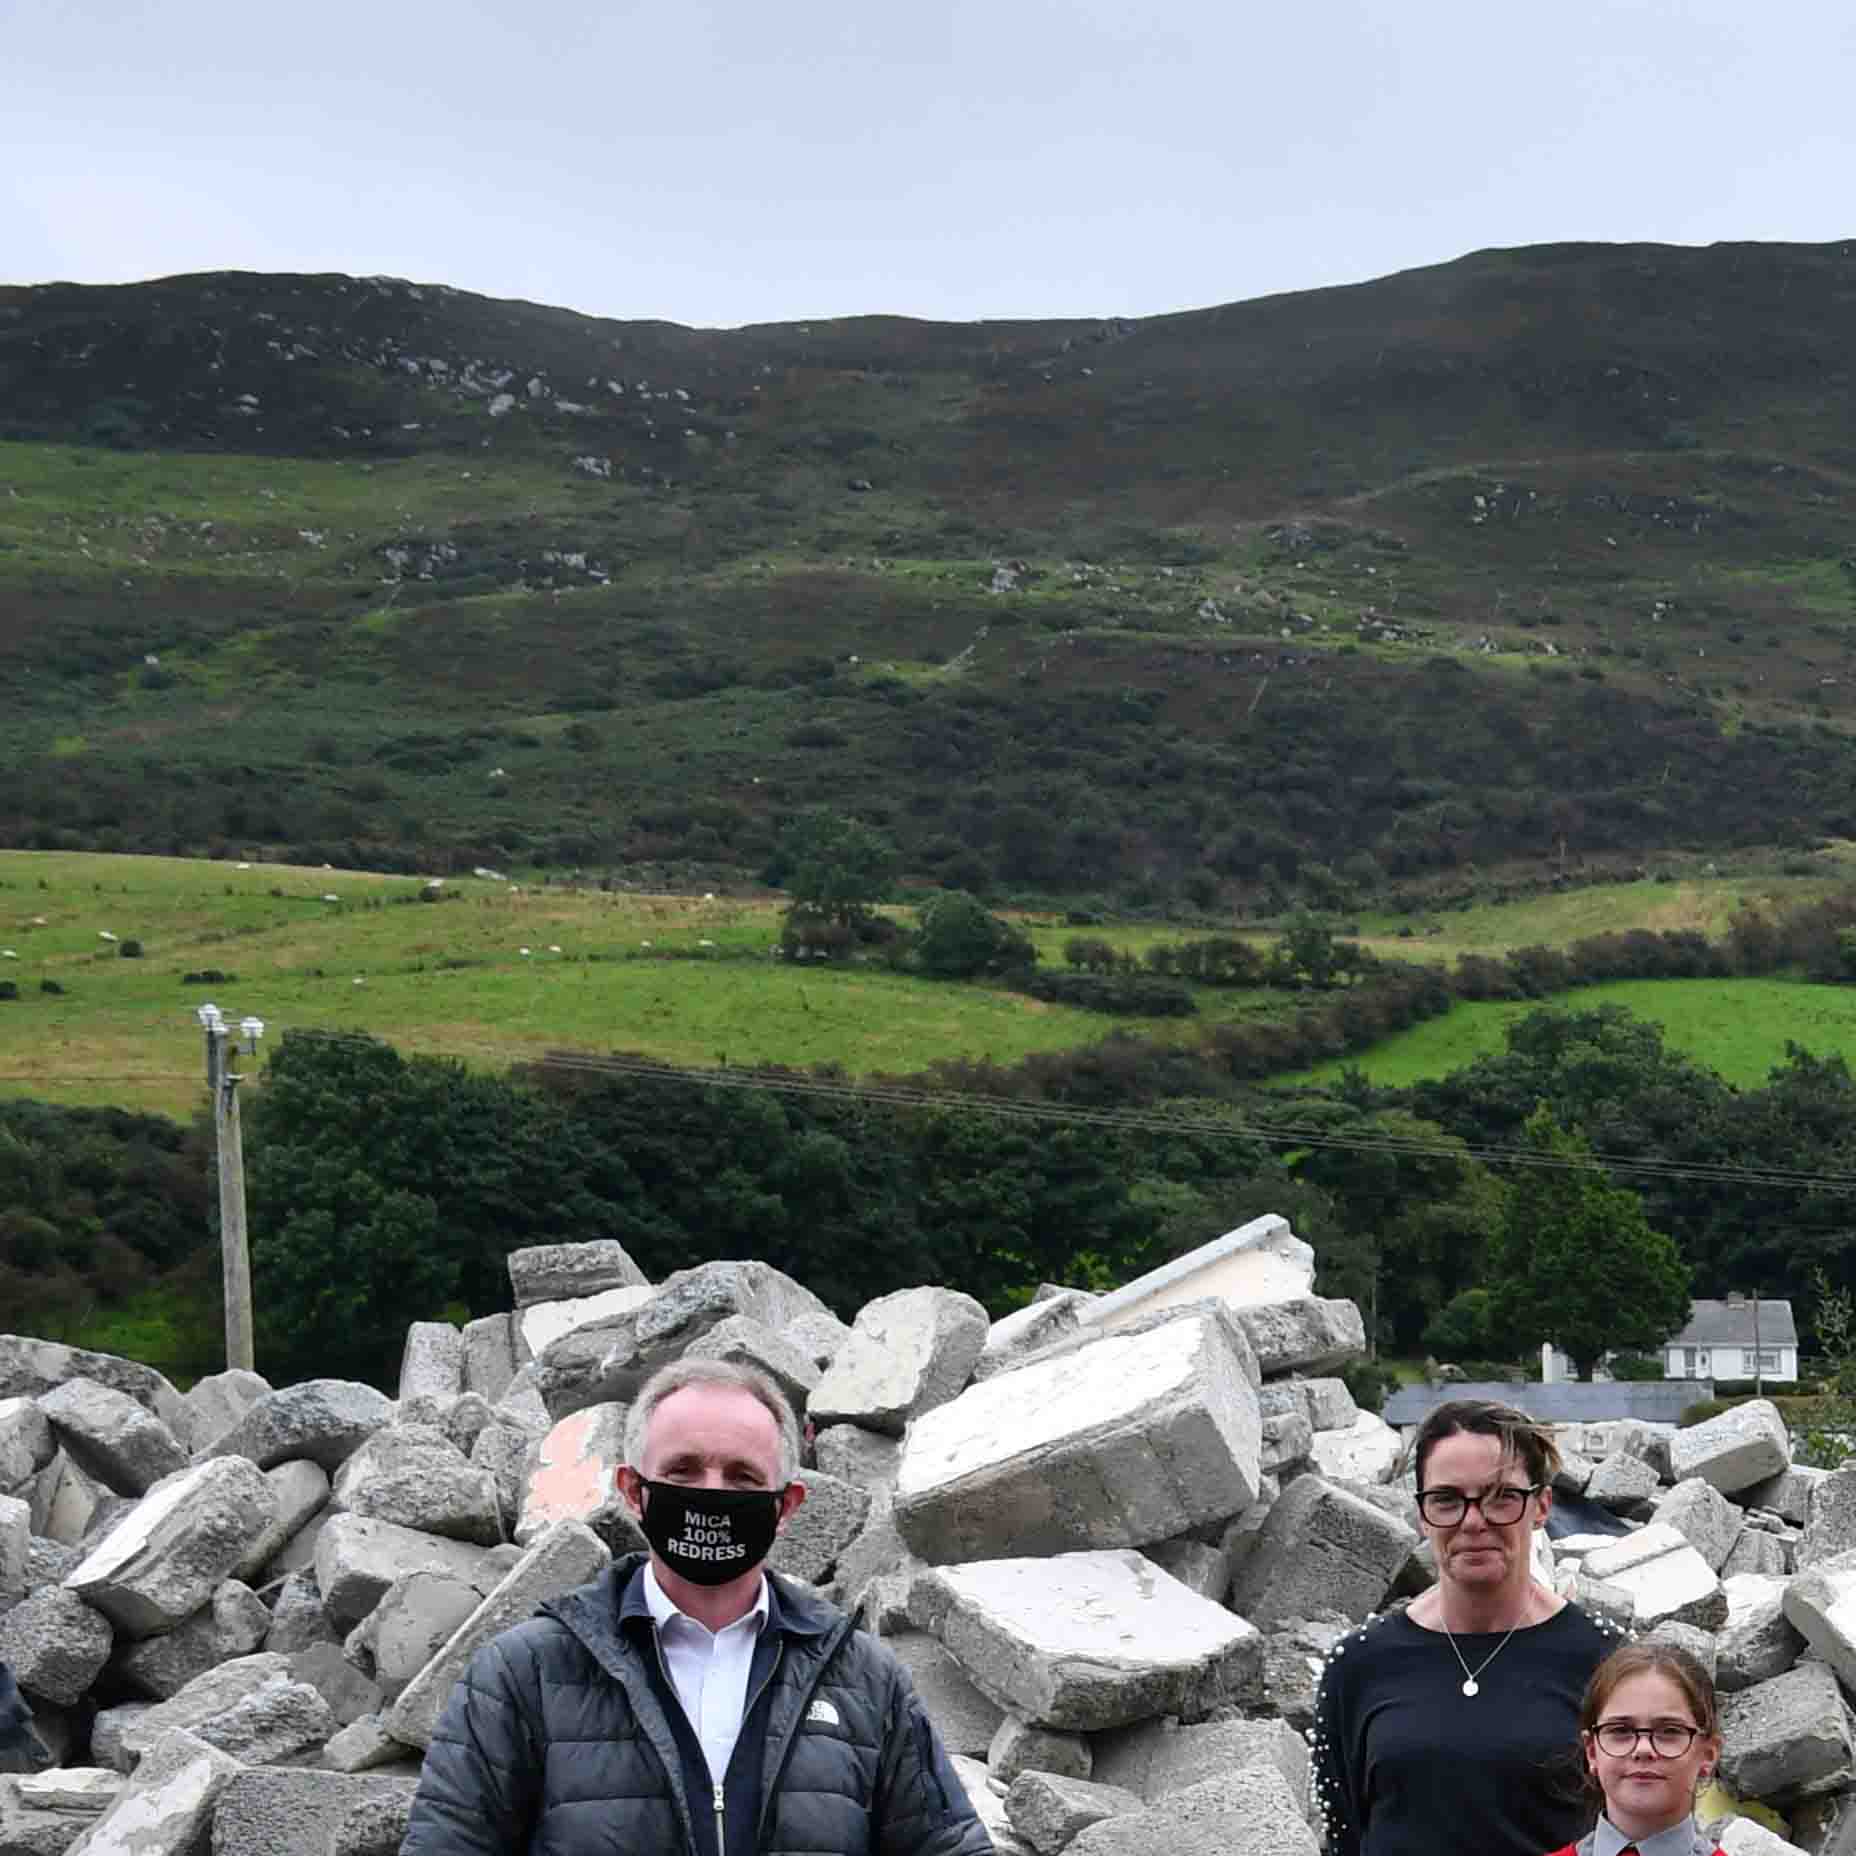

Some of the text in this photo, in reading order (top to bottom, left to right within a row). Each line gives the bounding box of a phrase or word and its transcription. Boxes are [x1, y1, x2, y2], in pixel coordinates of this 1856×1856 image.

[685, 1510, 731, 1528] MICA
[683, 1526, 732, 1544] 100%
[667, 1538, 747, 1561] REDRESS
